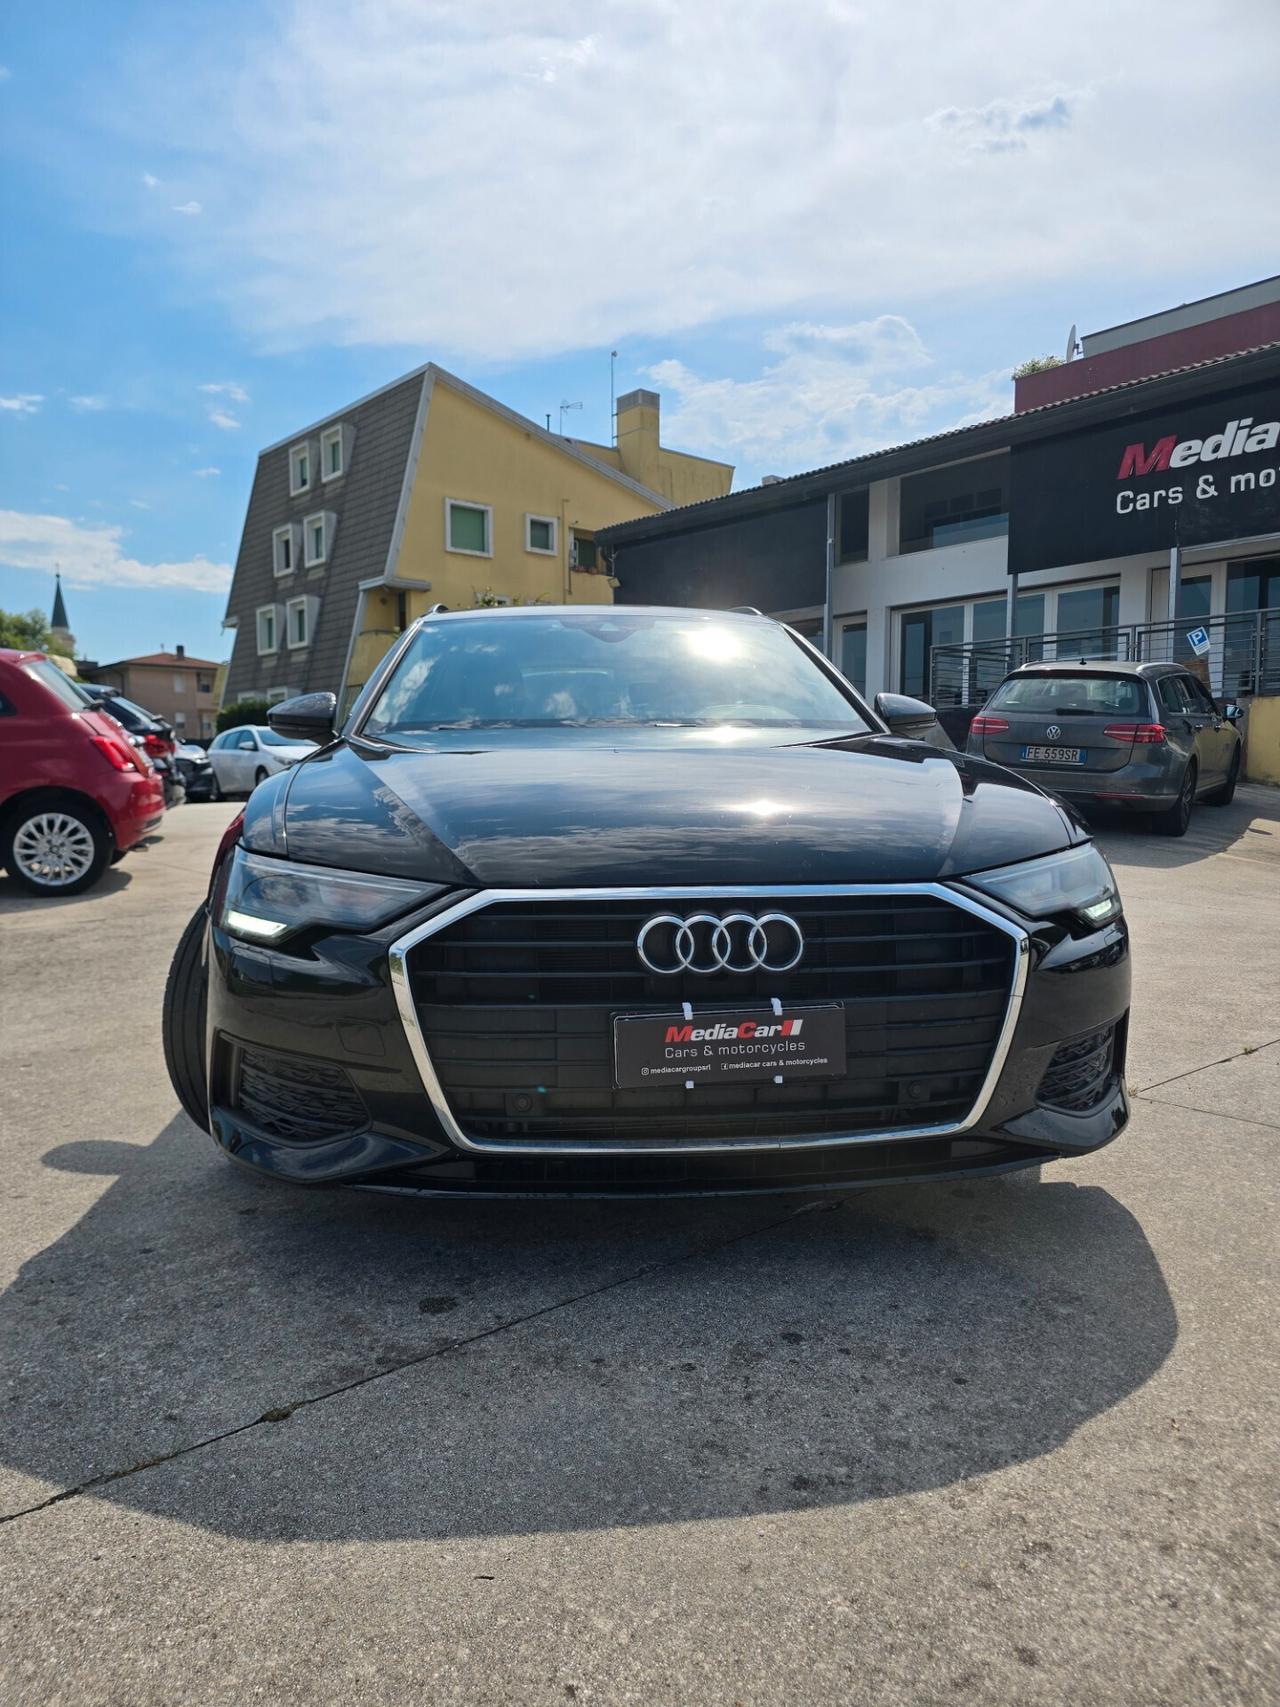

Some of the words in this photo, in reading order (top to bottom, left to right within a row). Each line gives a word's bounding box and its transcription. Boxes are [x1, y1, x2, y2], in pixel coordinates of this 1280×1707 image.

[1116, 486, 1183, 514] Cars
[1196, 474, 1218, 500] &
[1230, 466, 1280, 494] mo
[1191, 631, 1203, 646] P
[1027, 747, 1040, 758] FE
[1044, 748, 1078, 761] 559SR
[664, 1047, 698, 1059] Cars
[703, 1045, 713, 1056] &
[718, 1040, 806, 1055] motorcycles
[728, 1061, 761, 1069] mediacar
[785, 1057, 828, 1066] motorcycles
